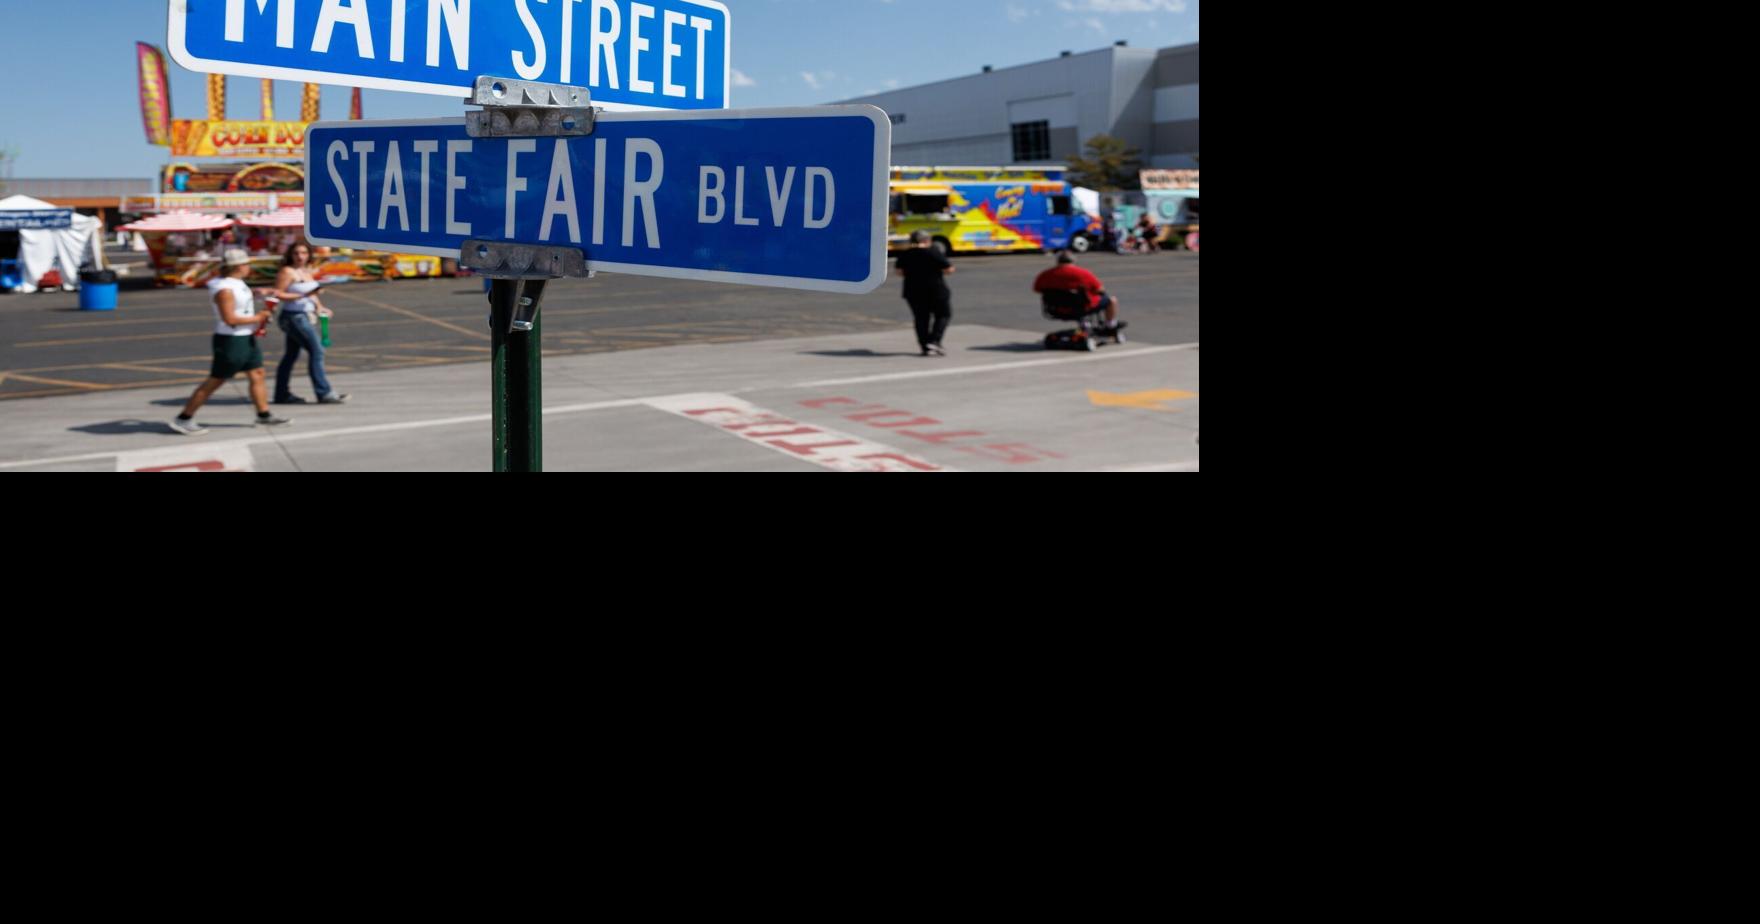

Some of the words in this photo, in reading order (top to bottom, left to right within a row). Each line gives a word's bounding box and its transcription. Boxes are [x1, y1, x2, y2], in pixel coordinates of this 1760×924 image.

[511, 0, 713, 100] STREET
[325, 139, 473, 236] STATE
[504, 137, 665, 249] FAIR
[698, 165, 836, 229] BLVD
